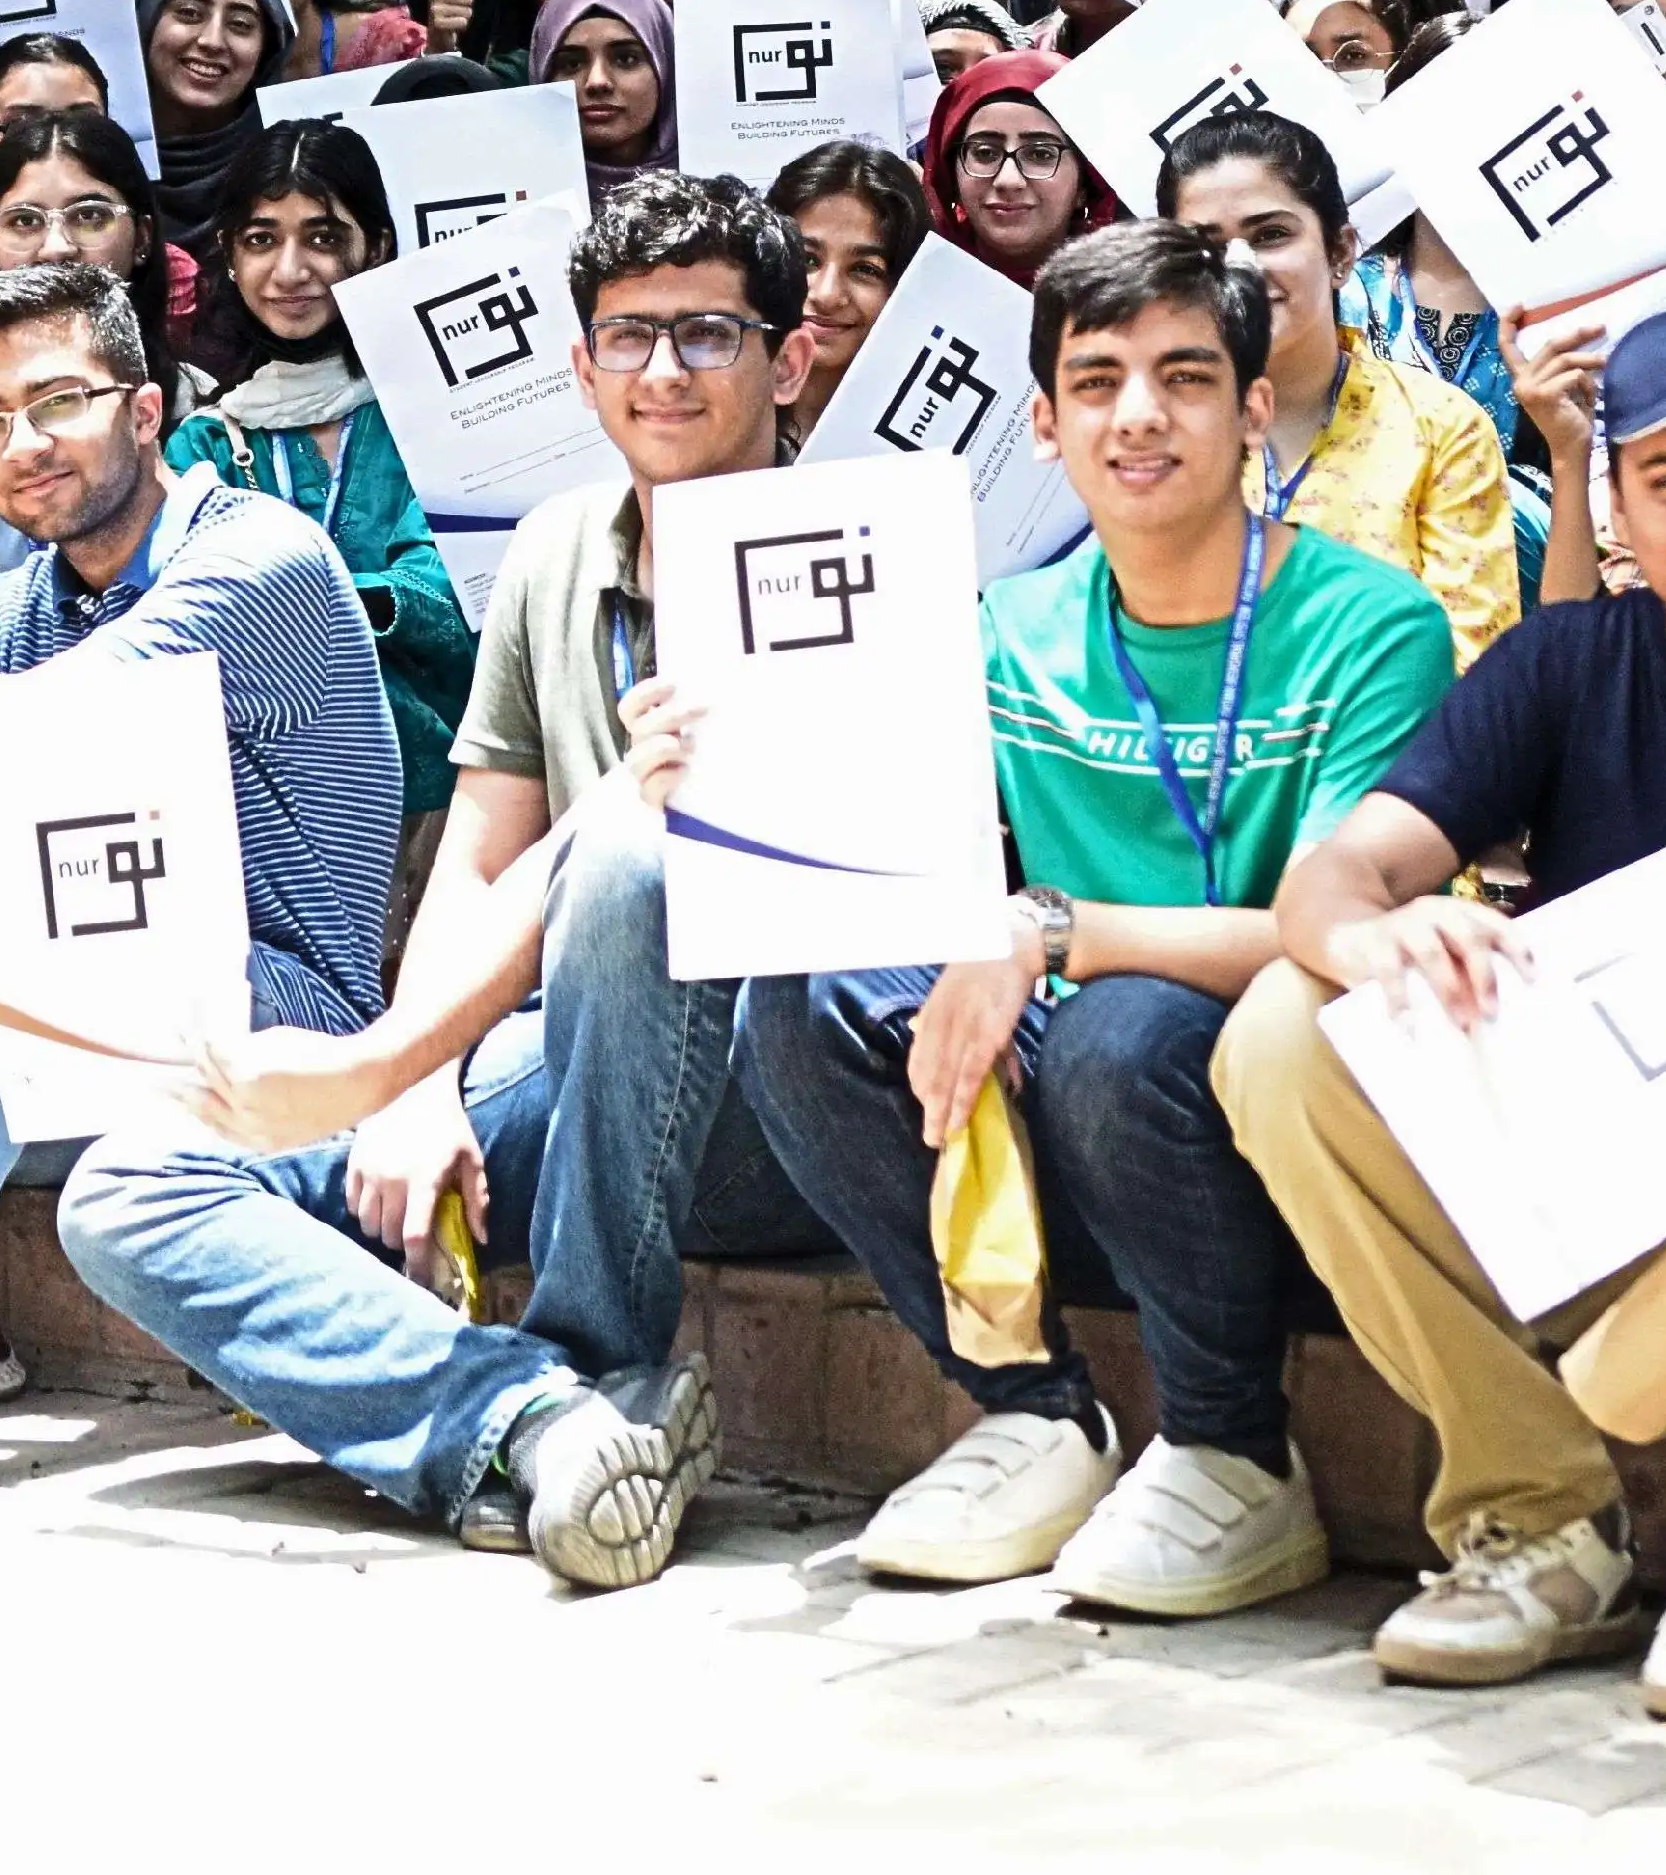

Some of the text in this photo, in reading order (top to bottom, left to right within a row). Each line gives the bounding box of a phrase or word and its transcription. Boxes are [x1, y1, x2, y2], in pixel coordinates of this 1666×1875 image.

[748, 48, 781, 64] nur
[731, 117, 846, 131] ENLIGHTENING MINDS
[1513, 155, 1553, 193] nur
[441, 313, 480, 341] nur
[450, 366, 573, 421] ENLIGHTENING MINDS
[461, 381, 572, 430] BUILDING FUTURES
[909, 397, 939, 439] nur
[757, 573, 802, 595] nur
[59, 855, 100, 879] nur
